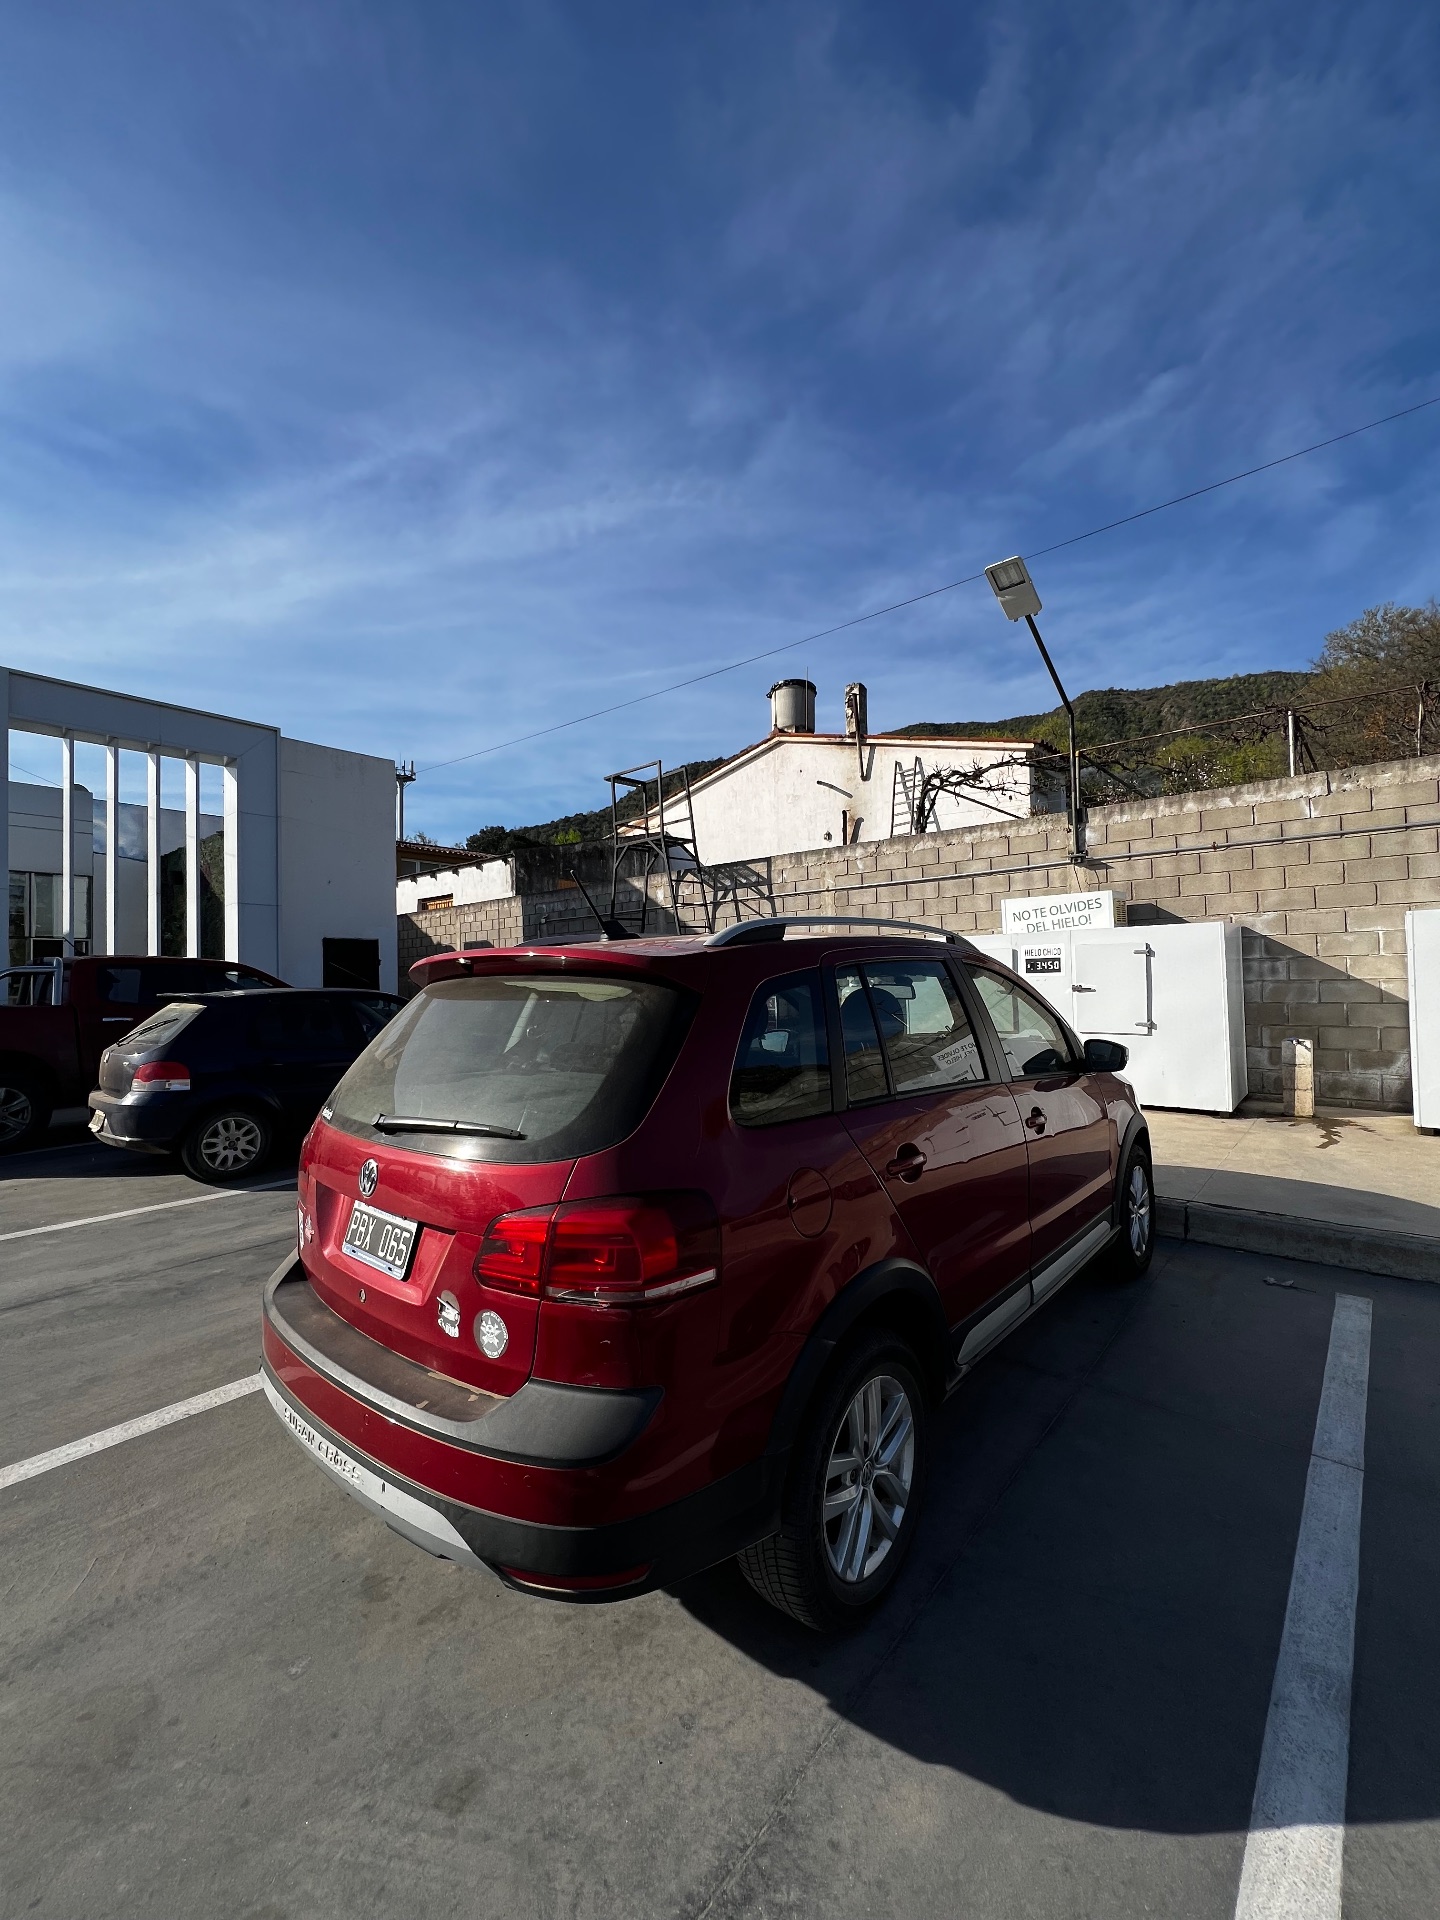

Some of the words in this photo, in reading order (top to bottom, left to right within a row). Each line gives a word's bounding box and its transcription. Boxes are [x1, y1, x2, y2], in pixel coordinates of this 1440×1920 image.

[1012, 910, 1031, 922] NO
[1032, 907, 1047, 919] TE
[1049, 897, 1103, 916] OLVIDES
[1026, 921, 1050, 934] DEL
[1051, 914, 1092, 931] HIELO!
[1024, 948, 1042, 957] HIELO
[346, 1210, 377, 1251] PBX
[377, 1224, 411, 1266] 065
[318, 1441, 362, 1484] CROSS
